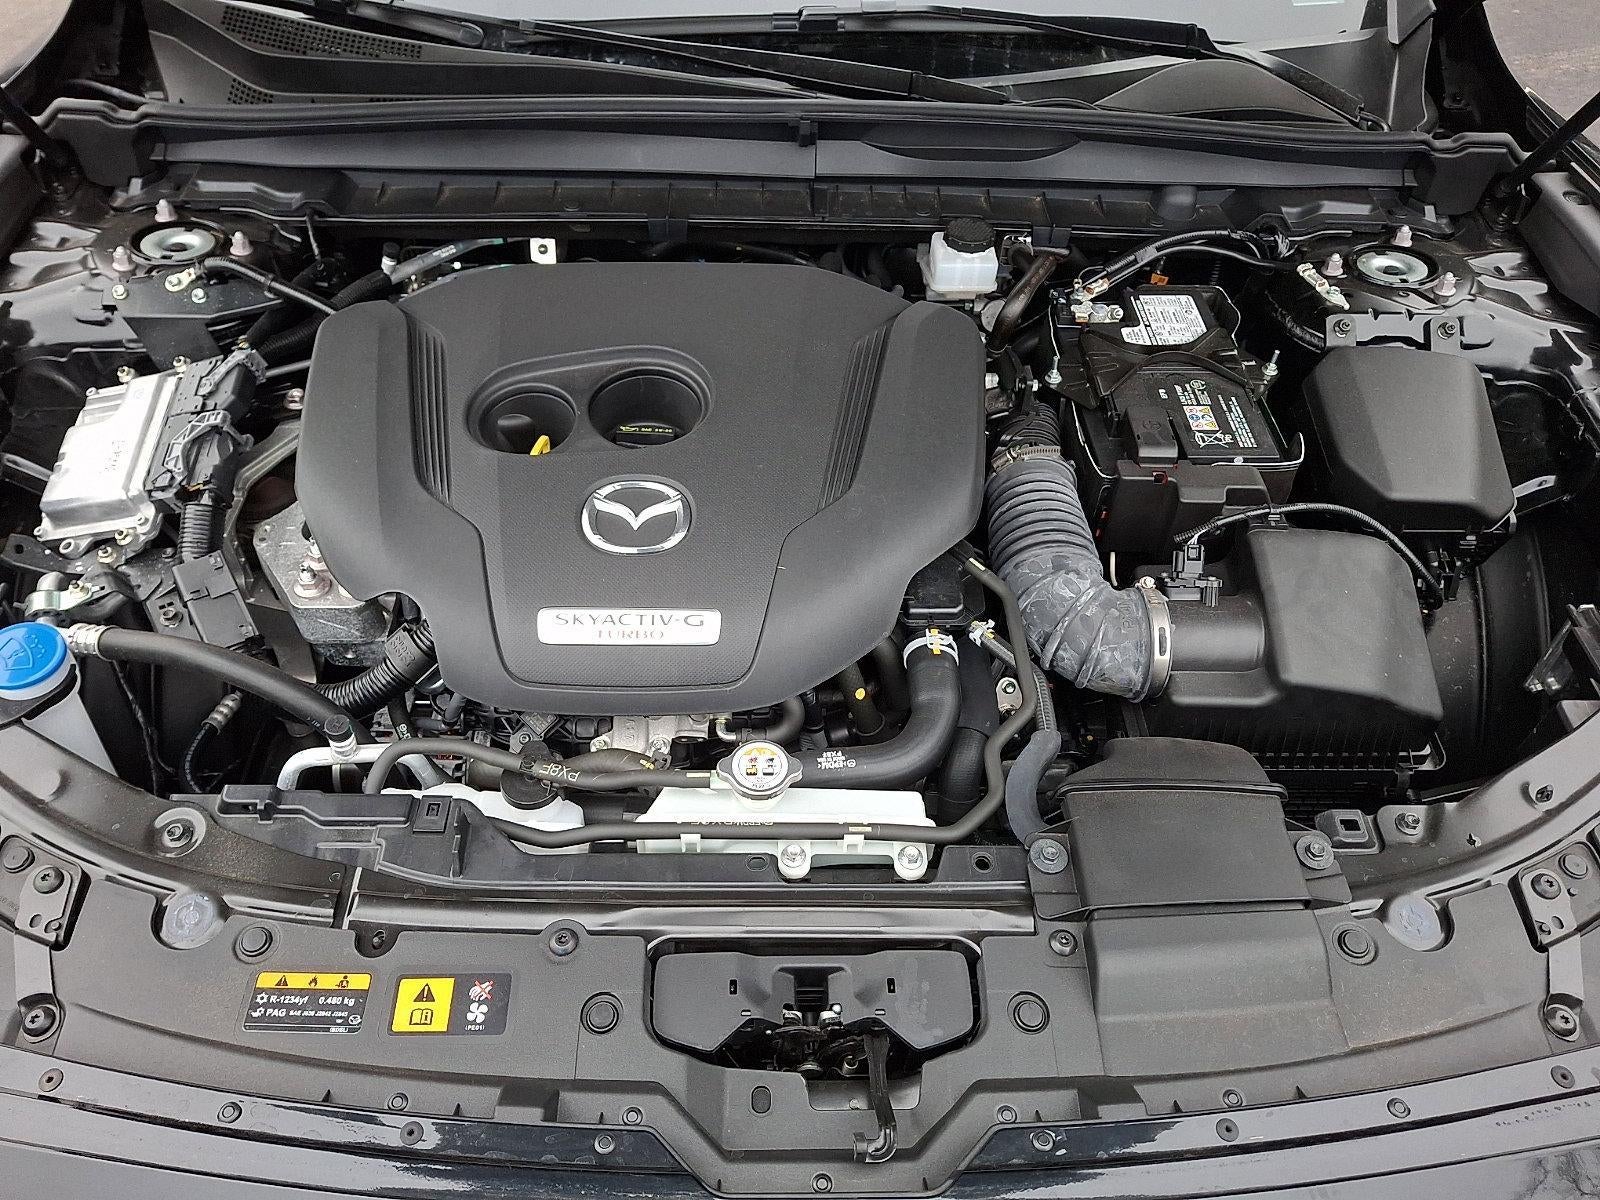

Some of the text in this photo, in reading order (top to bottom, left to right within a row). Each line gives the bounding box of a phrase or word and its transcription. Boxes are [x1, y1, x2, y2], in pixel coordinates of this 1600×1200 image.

[555, 613, 705, 627] SKYACTIV-G
[539, 762, 581, 782] PX8F
[269, 995, 309, 1006] R-1234yf
[343, 996, 356, 1007] kg
[265, 1008, 287, 1017] PAG
